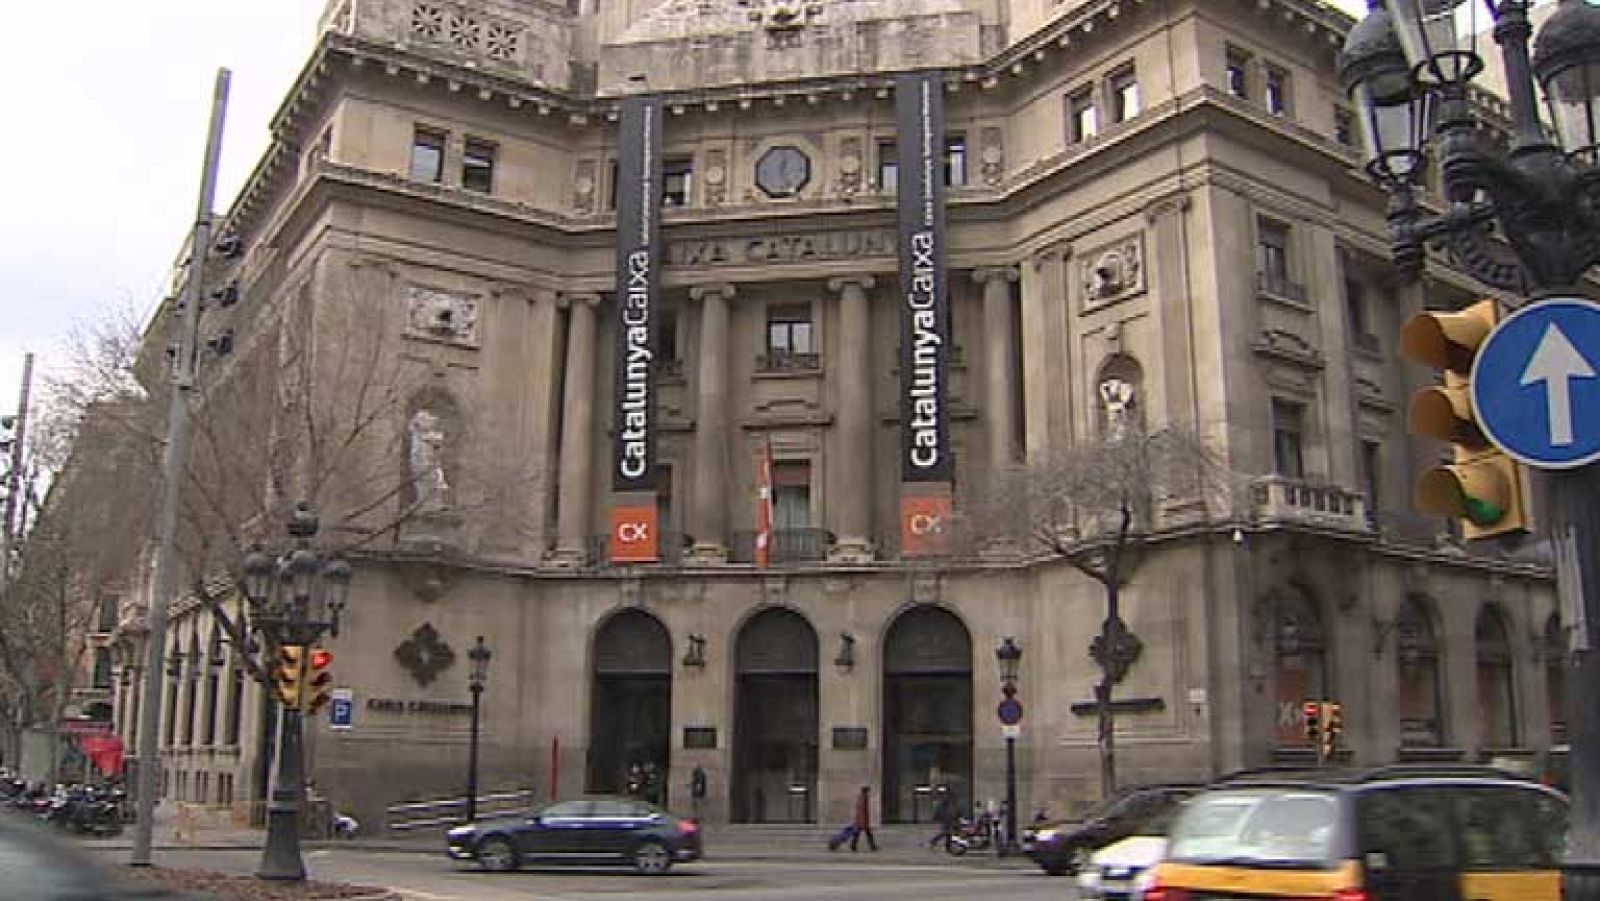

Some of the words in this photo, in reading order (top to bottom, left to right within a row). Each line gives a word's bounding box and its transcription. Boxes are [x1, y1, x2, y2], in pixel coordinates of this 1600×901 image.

[621, 251, 653, 478] CatalunyaCaixa
[908, 231, 942, 467] CatalunyaCaixa
[618, 522, 648, 542] CX
[334, 704, 349, 723] P
